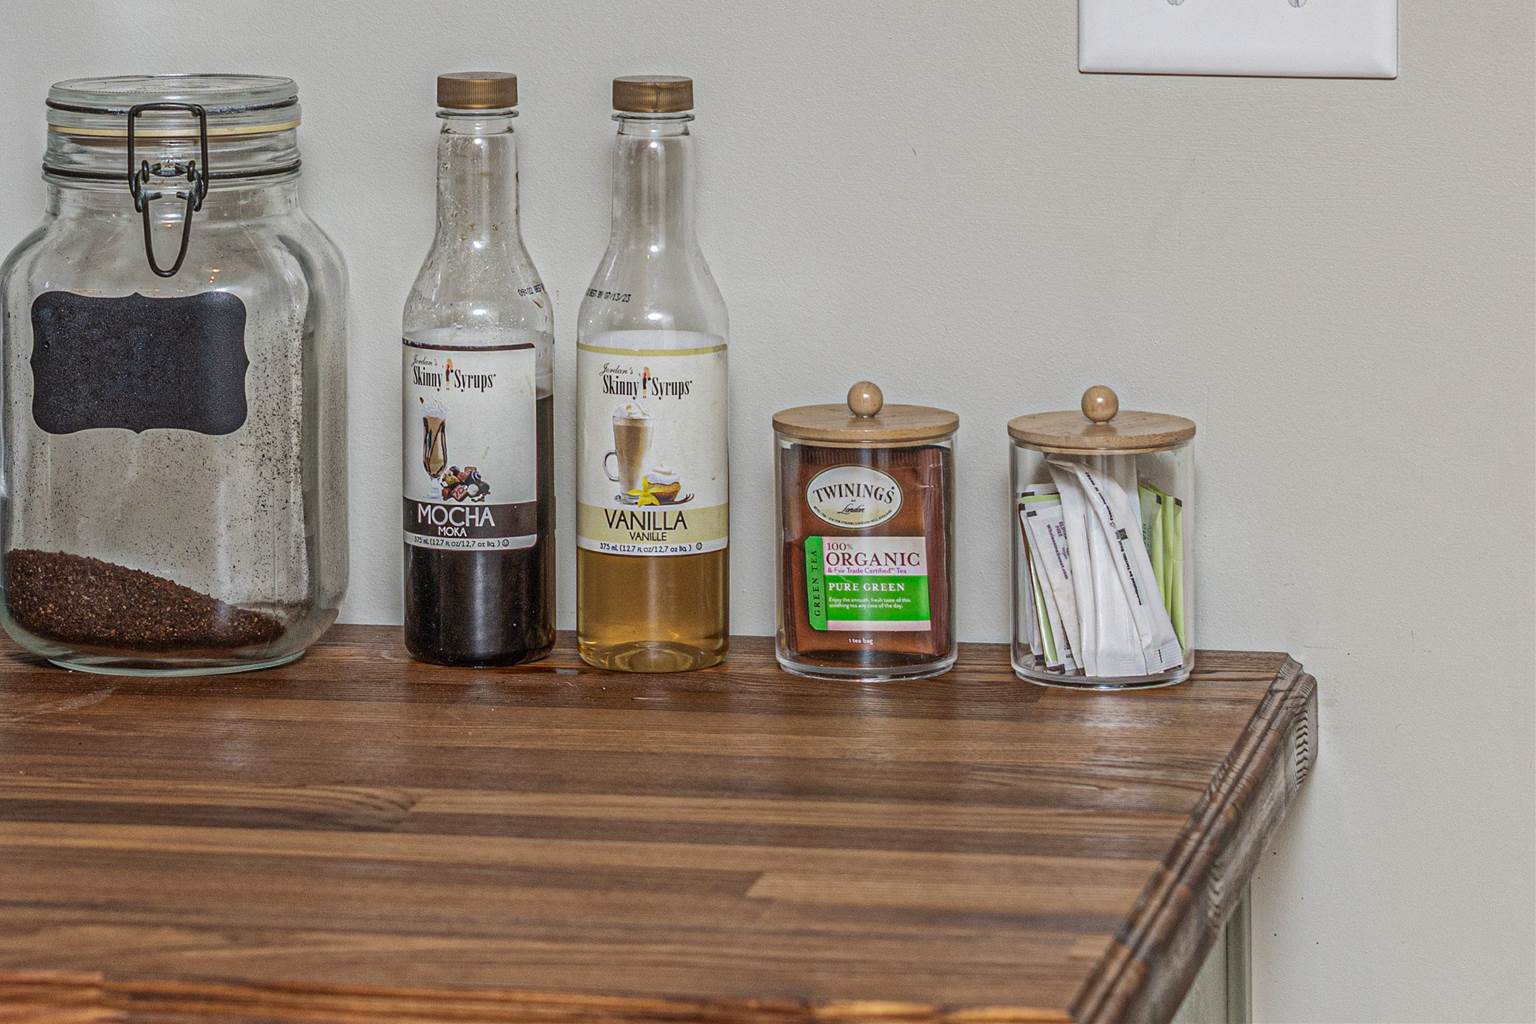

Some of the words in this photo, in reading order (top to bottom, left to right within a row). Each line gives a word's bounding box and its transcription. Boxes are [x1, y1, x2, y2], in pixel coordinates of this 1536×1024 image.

[413, 365, 443, 392] Skinny
[454, 368, 495, 393] Syrups
[602, 374, 639, 400] Skinny
[651, 376, 692, 400] Syrups
[812, 482, 896, 505] TWININGS
[417, 503, 496, 527] MOCHA
[604, 508, 688, 531] VANILLA
[437, 526, 468, 537] MOKA
[628, 532, 668, 542] VANILLE
[810, 550, 818, 573] TEA
[825, 551, 921, 567] ORGANIC
[811, 577, 822, 617] GREEN
[828, 582, 860, 592] PURE
[863, 582, 906, 593] GREEN
[852, 637, 862, 645] tea
[862, 636, 874, 646] bag
